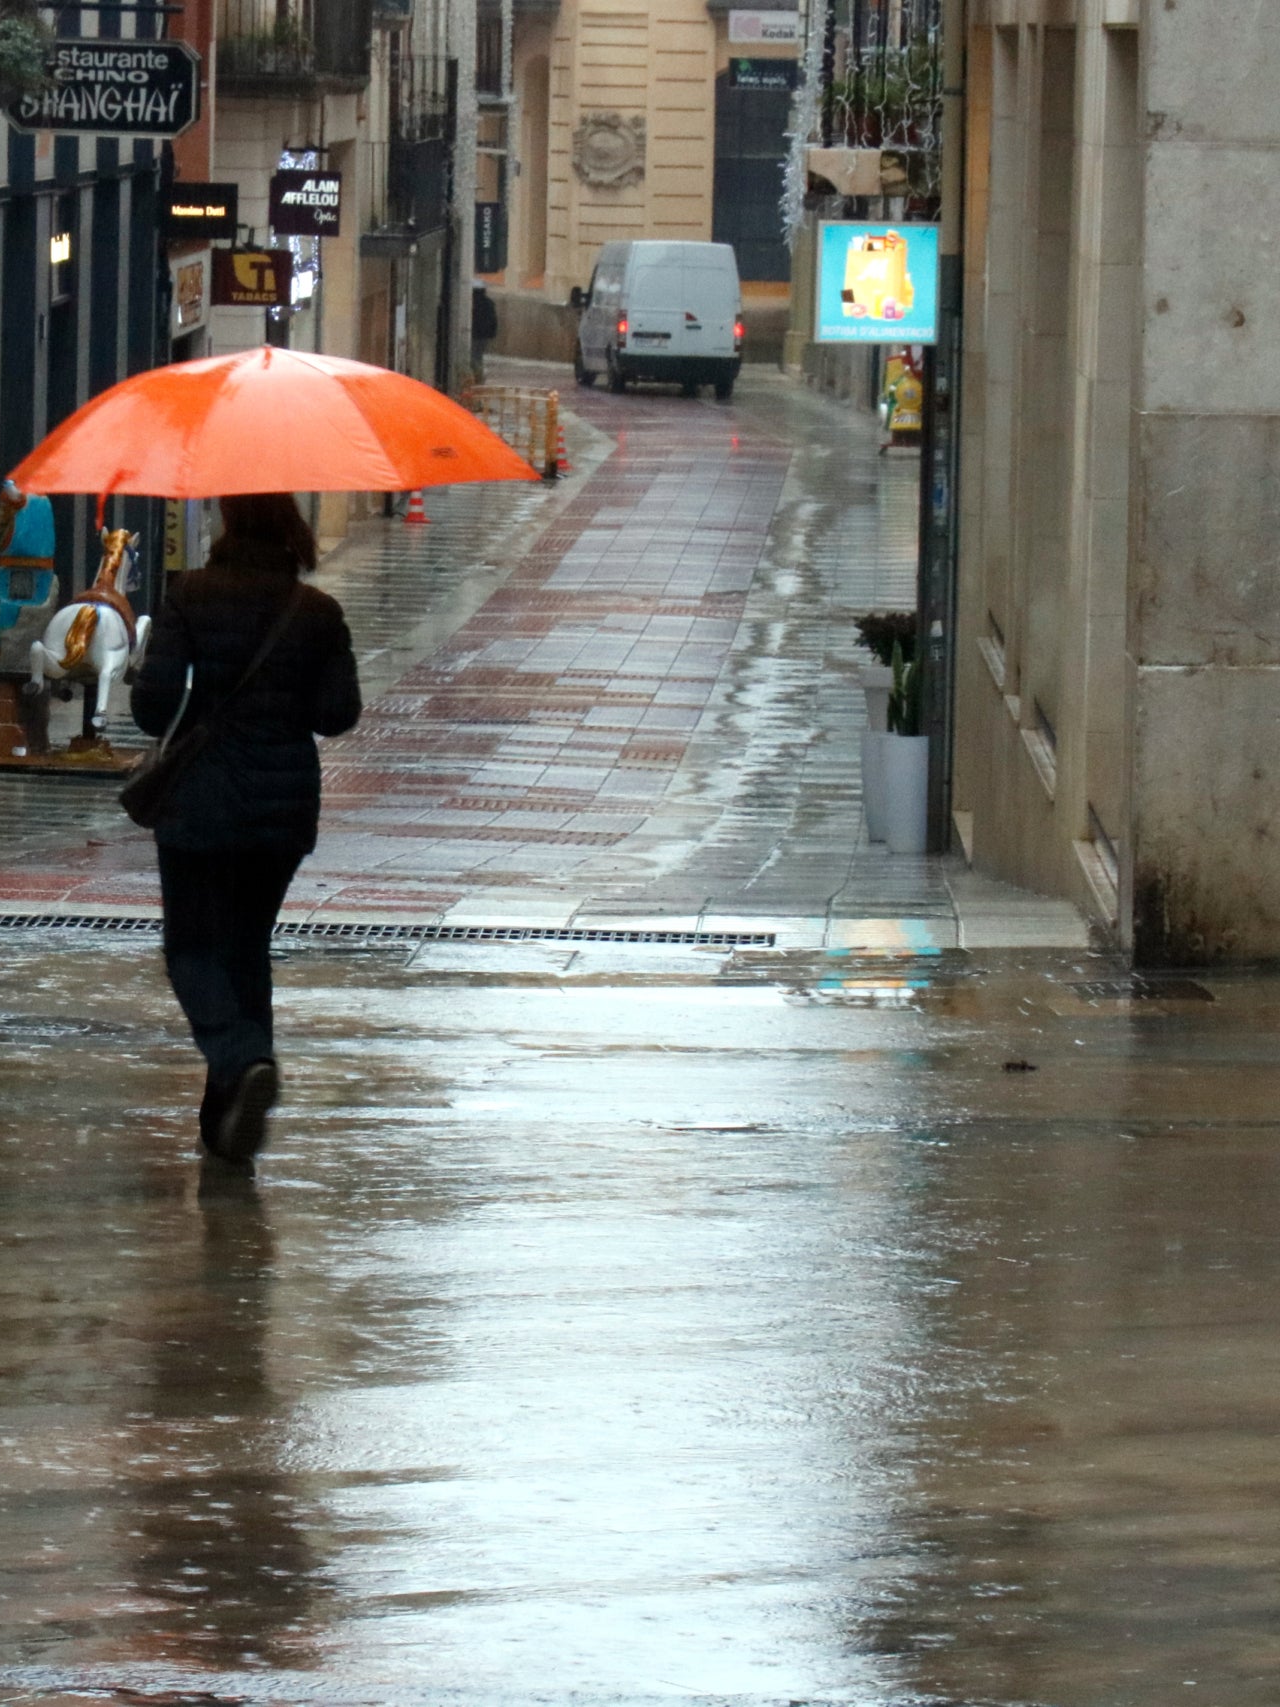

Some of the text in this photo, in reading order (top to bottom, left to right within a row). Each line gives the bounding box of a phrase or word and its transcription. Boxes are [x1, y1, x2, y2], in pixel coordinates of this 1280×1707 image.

[761, 28, 795, 38] Kodak
[46, 46, 168, 69] staurante
[53, 68, 149, 84] CHINO
[301, 179, 339, 193] ALAIN
[281, 191, 339, 206] AFFLELOU
[483, 206, 492, 248] MISAKO
[232, 292, 277, 302] TABACS
